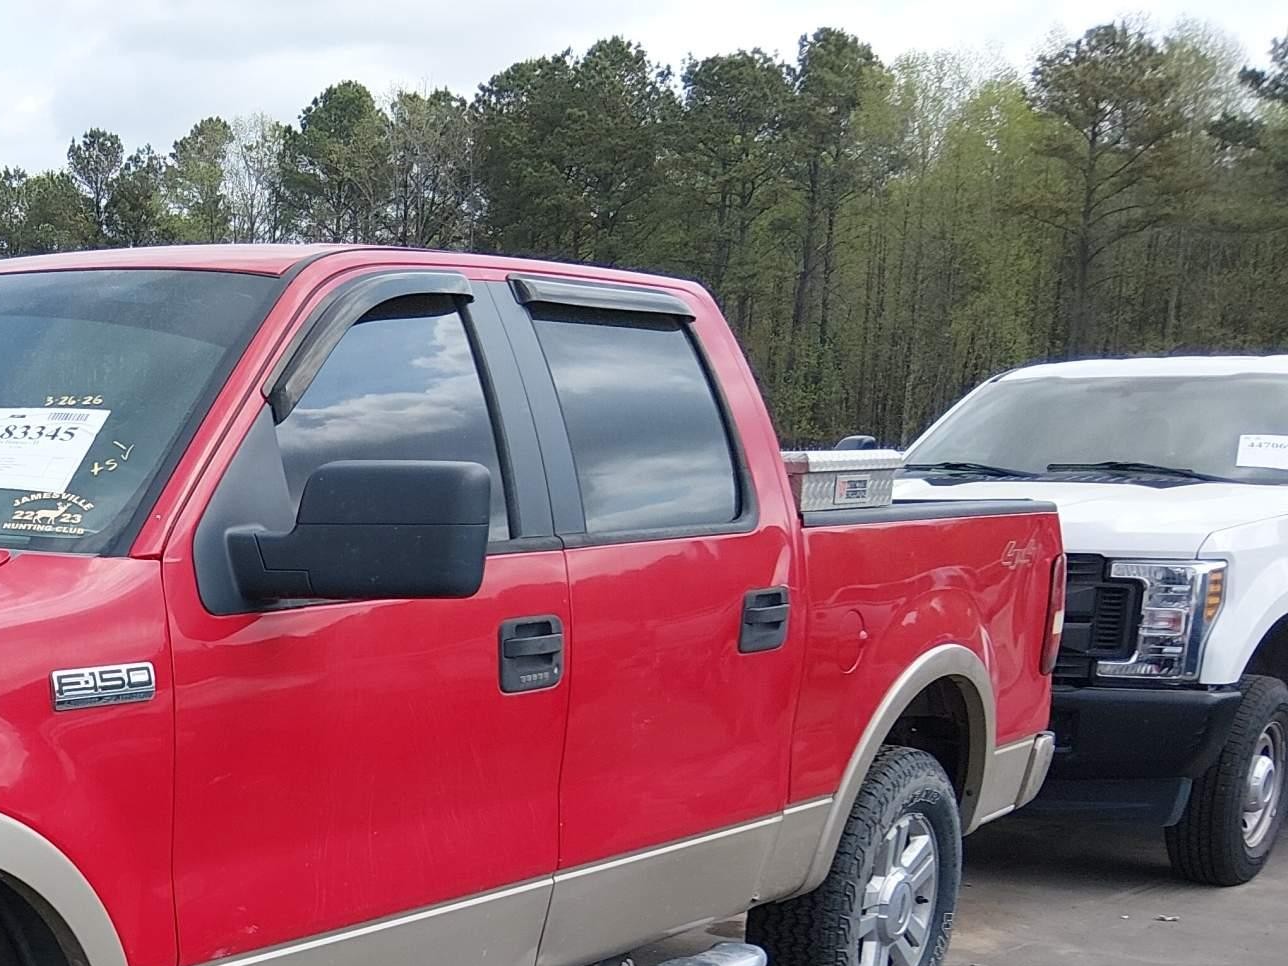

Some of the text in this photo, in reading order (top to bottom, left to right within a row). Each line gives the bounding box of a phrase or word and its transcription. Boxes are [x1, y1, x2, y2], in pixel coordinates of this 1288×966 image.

[13, 492, 94, 511] JAMESVILLE
[59, 513, 82, 524] 23
[3, 522, 84, 534] HUNTING CLUB
